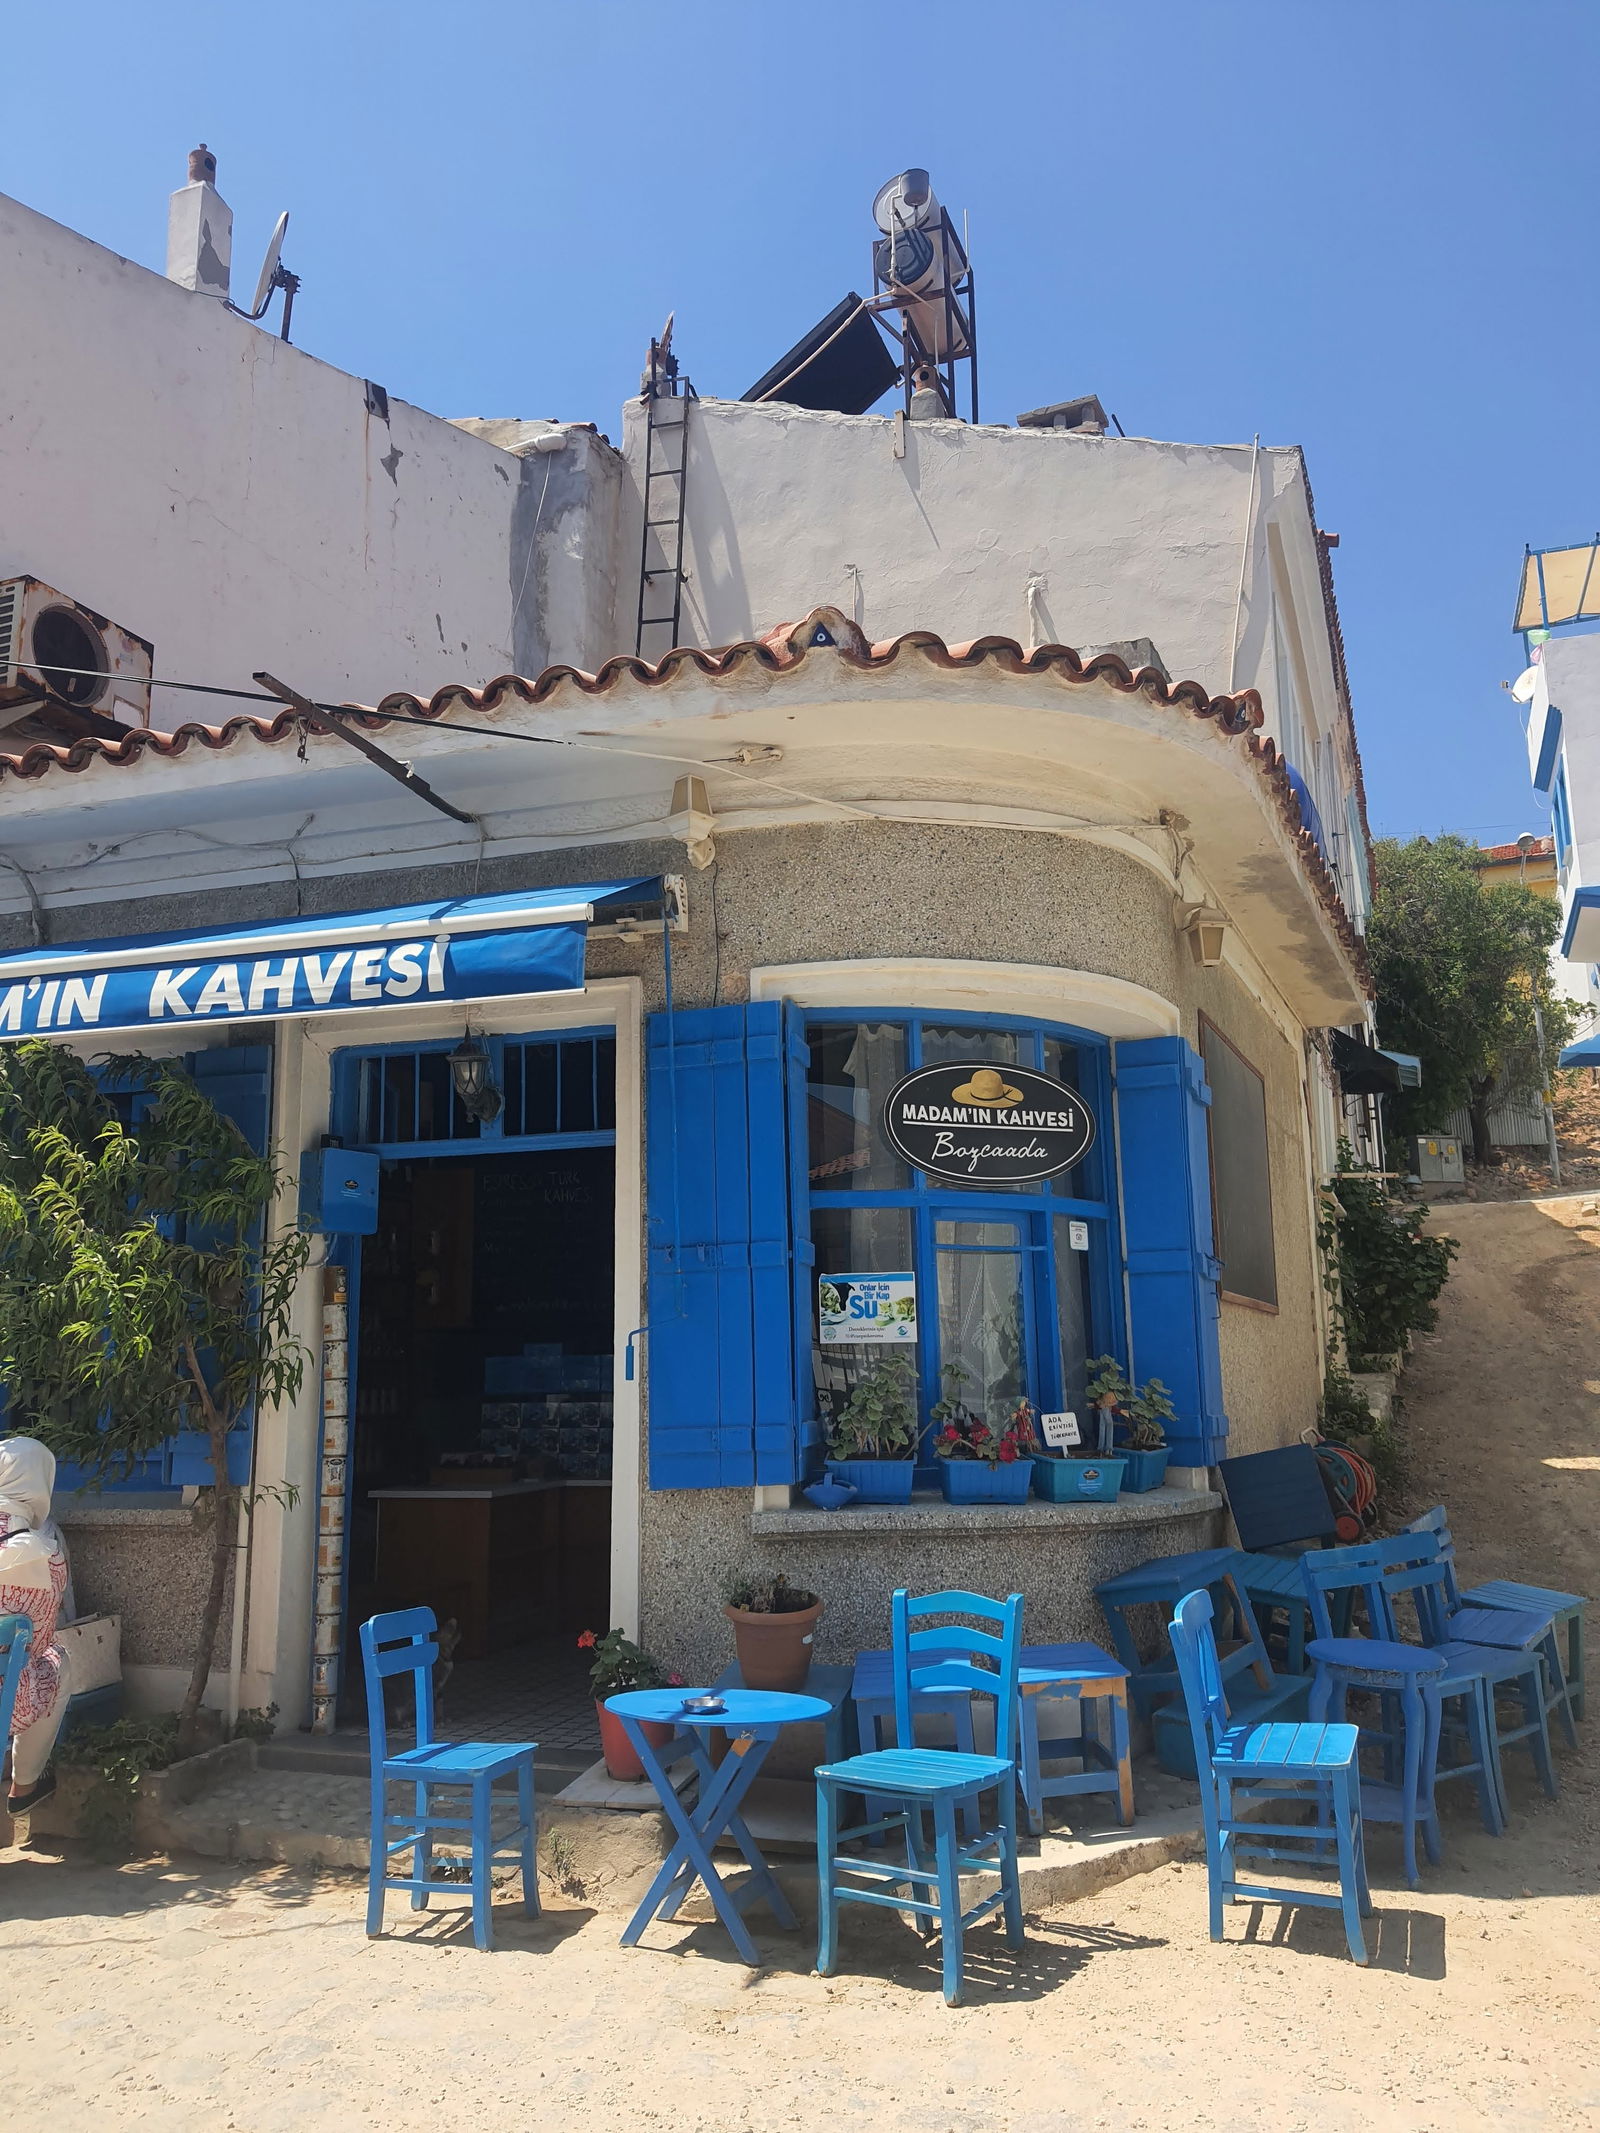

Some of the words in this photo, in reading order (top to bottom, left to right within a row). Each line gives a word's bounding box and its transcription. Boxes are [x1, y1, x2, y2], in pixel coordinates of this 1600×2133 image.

[148, 934, 451, 1018] KAHVESİ
[902, 1103, 991, 1124] MADAM'IN
[997, 1107, 1074, 1127] KAHVESİ
[931, 1131, 1048, 1173] Bozcaada
[859, 1283, 876, 1292] Onlar
[864, 1292, 874, 1300] Bir
[876, 1292, 890, 1301] Kap
[850, 1295, 878, 1319] Su
[1048, 1416, 1062, 1424] ADA
